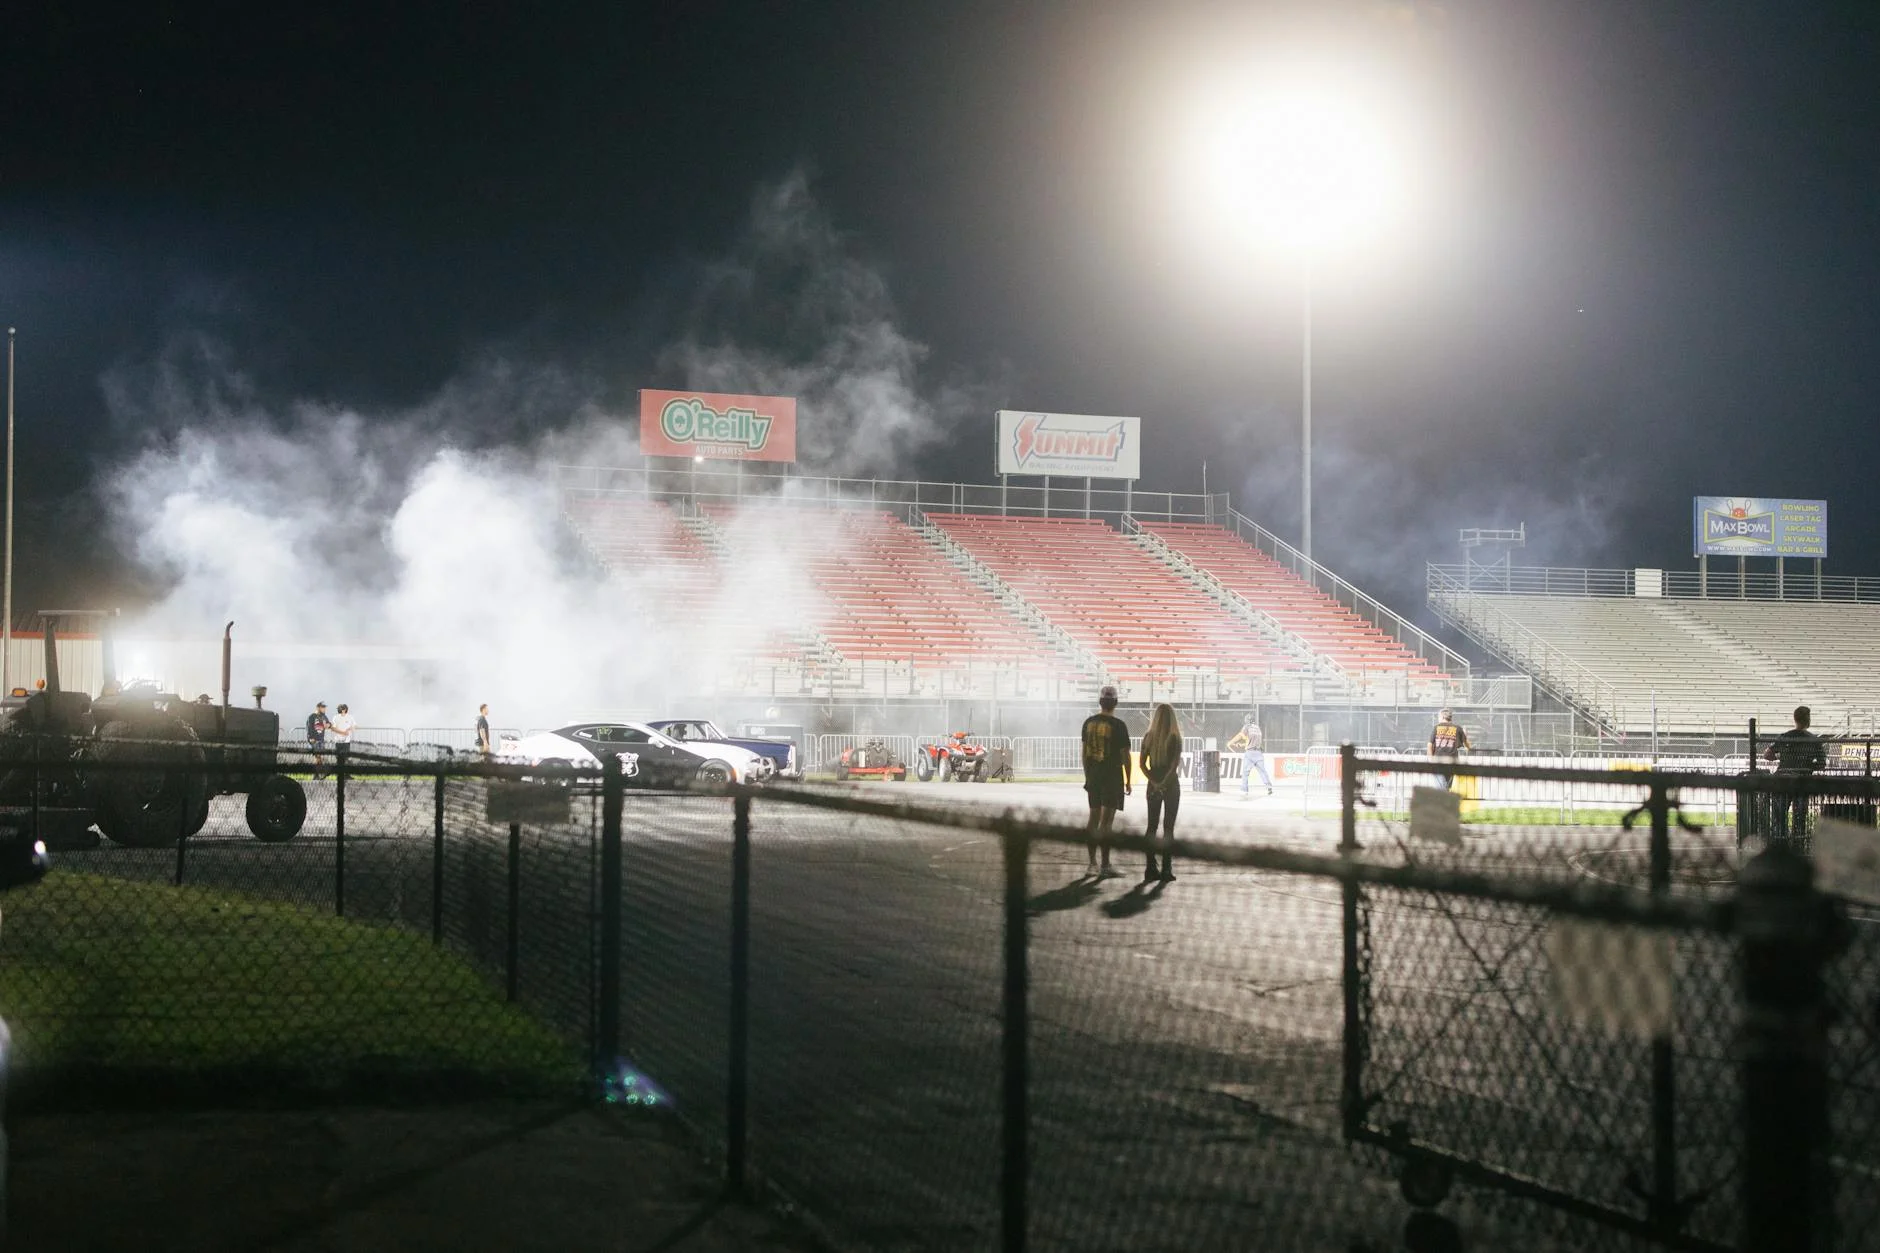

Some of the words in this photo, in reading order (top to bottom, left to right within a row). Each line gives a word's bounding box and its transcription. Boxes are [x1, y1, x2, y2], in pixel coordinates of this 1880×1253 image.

[662, 401, 771, 448] O'Reilly
[695, 445, 716, 455] AUTO
[718, 446, 744, 456] PARTS
[1782, 504, 1820, 512] BOWLING
